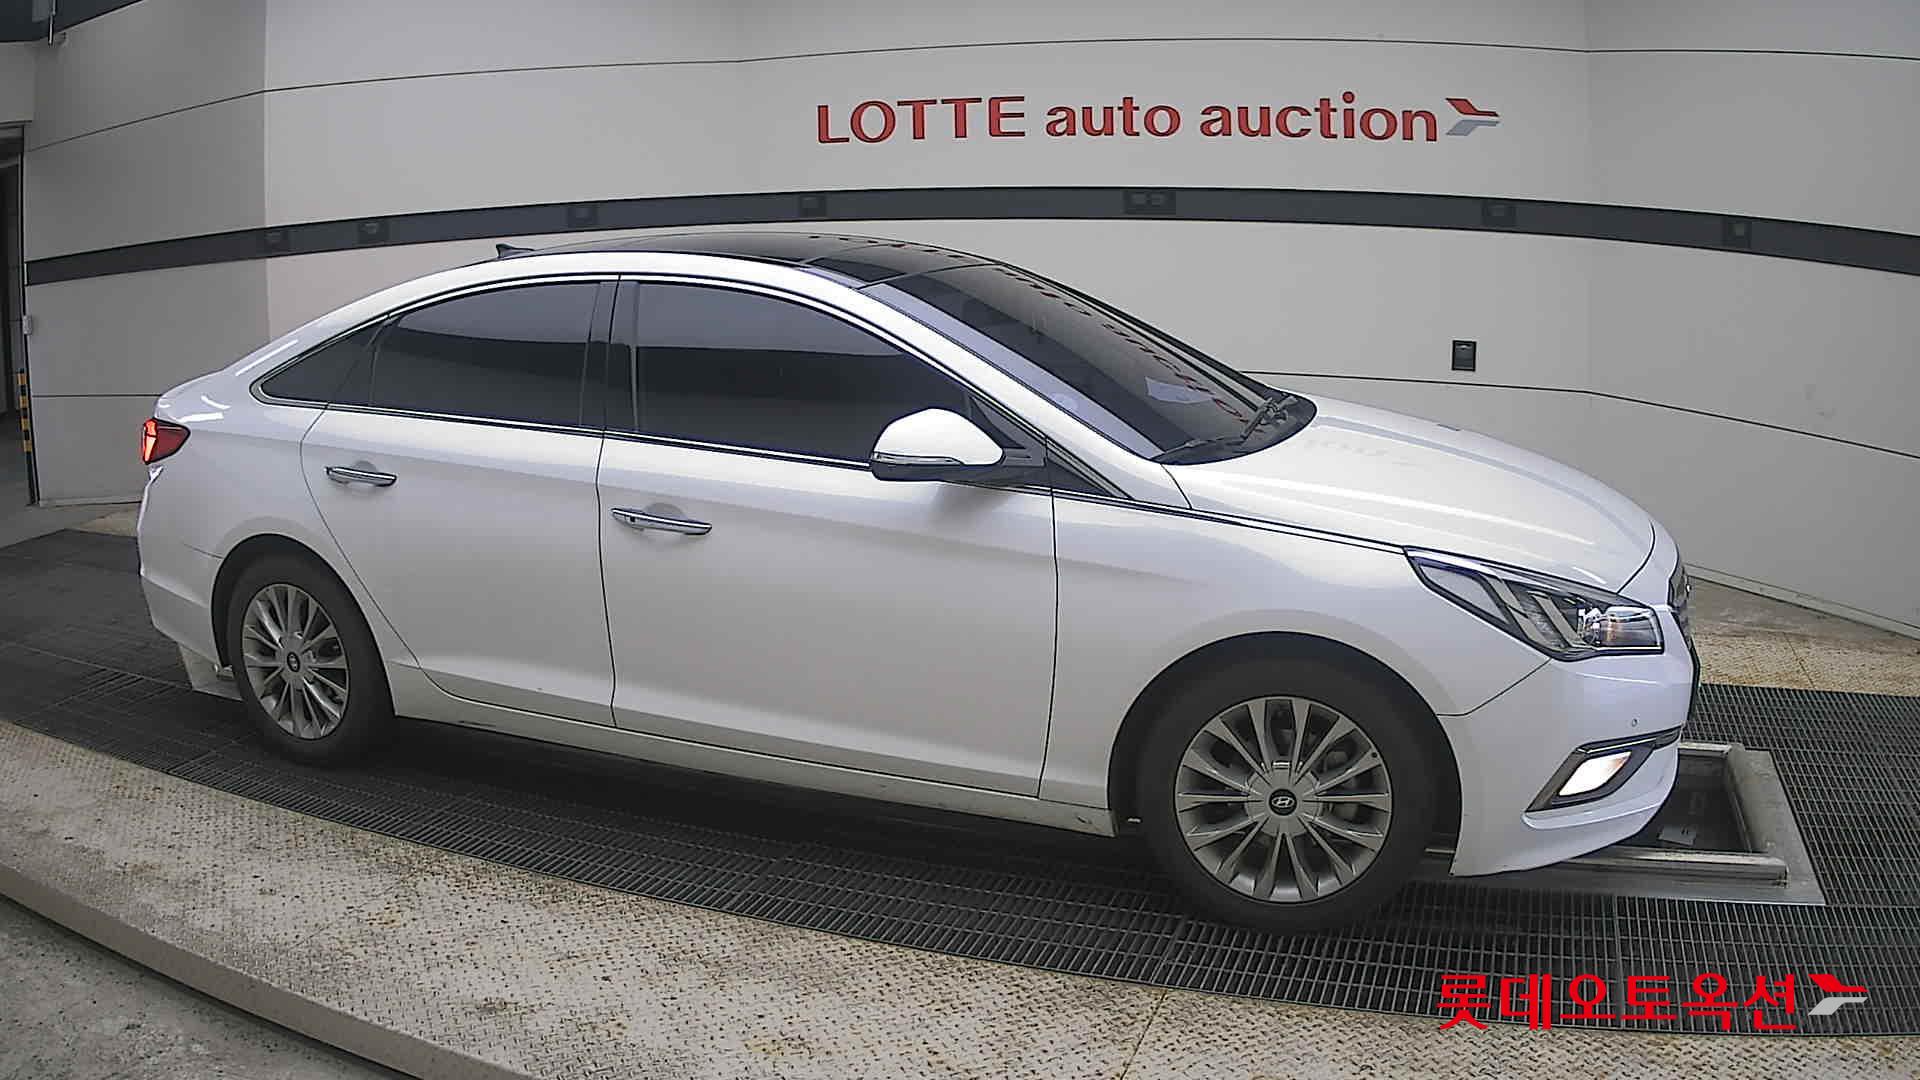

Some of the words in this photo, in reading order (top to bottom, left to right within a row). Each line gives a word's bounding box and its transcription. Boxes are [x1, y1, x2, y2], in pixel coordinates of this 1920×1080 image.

[817, 95, 1024, 143] LOTTE
[1047, 96, 1181, 137] auto
[1200, 91, 1438, 141] auction
